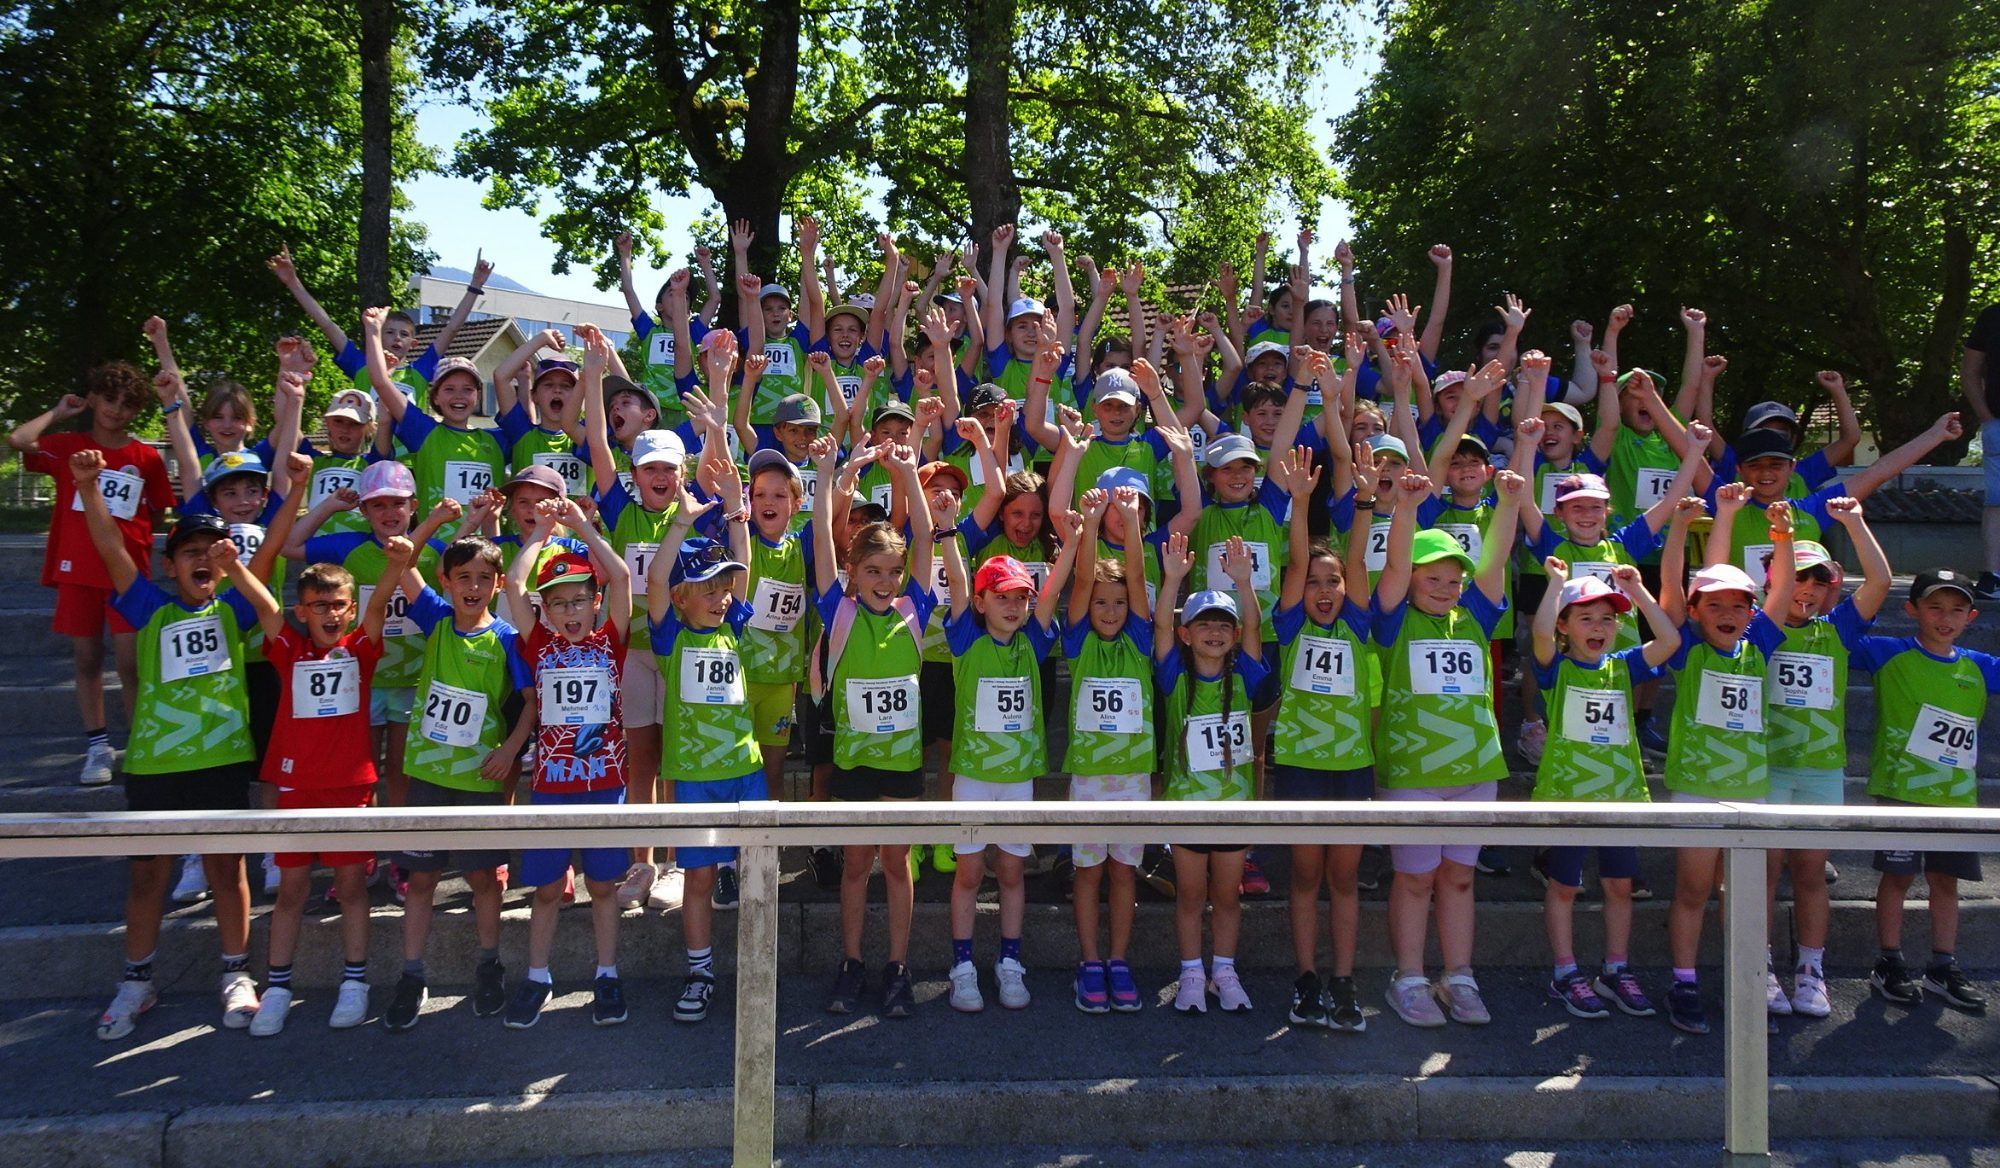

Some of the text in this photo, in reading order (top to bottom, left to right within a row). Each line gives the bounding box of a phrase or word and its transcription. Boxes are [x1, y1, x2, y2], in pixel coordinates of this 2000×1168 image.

[765, 350, 788, 364] 201
[458, 470, 491, 490] 142
[770, 592, 801, 614] 154
[172, 628, 218, 657] 185
[694, 660, 735, 684] 188
[1305, 648, 1343, 675] 141
[1425, 651, 1473, 675] 136
[310, 671, 342, 696] 87
[1312, 673, 1333, 682] Emma
[1778, 663, 1813, 688] 53
[553, 679, 598, 704] 197
[862, 688, 908, 714] 138
[997, 689, 1025, 713] 55
[1092, 689, 1123, 713] 56
[1721, 686, 1748, 711] 58
[426, 693, 471, 725] 210
[1585, 701, 1615, 724] 54
[1201, 723, 1245, 749] 153
[1928, 720, 1974, 750] 209
[545, 755, 607, 783] MAN
